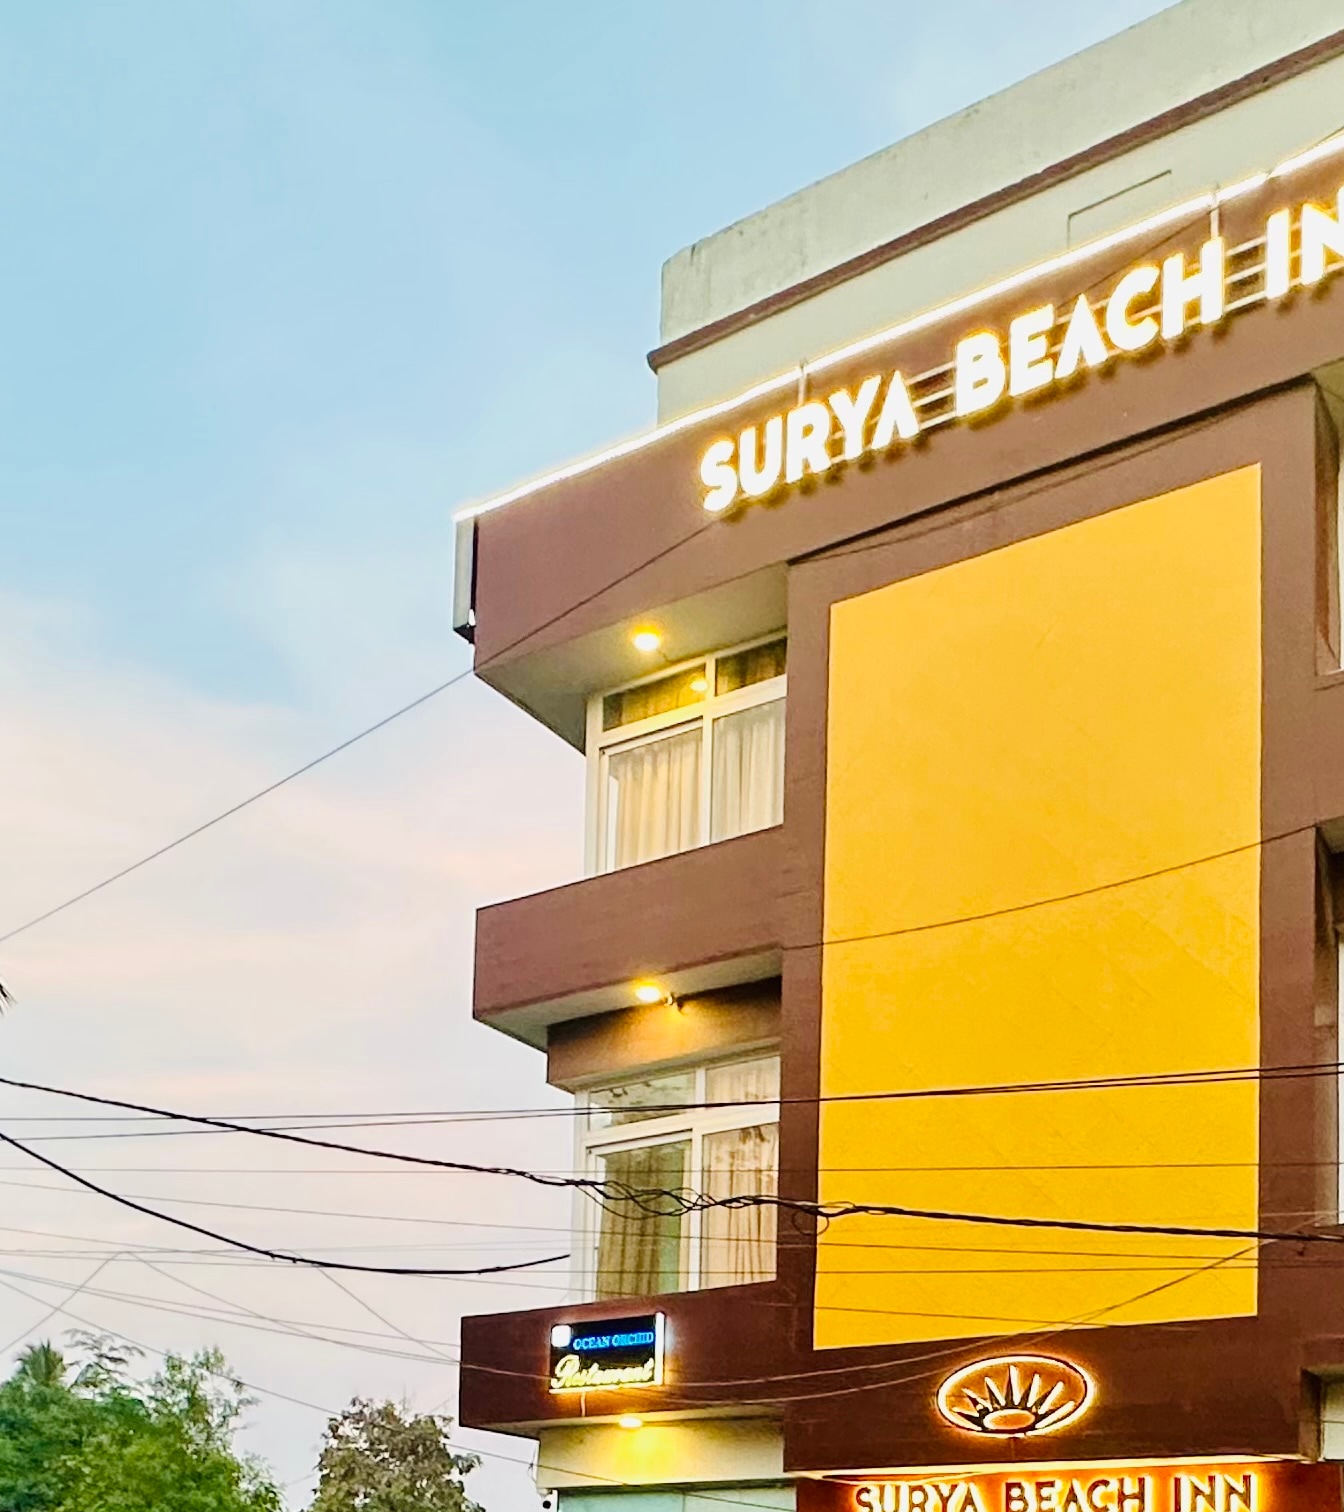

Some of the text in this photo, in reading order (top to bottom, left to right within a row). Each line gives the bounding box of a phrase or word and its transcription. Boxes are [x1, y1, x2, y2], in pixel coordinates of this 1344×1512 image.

[699, 368, 920, 513] SURYA
[953, 235, 1225, 417] BEACH
[573, 1331, 654, 1350] OCEAN ORCHID
